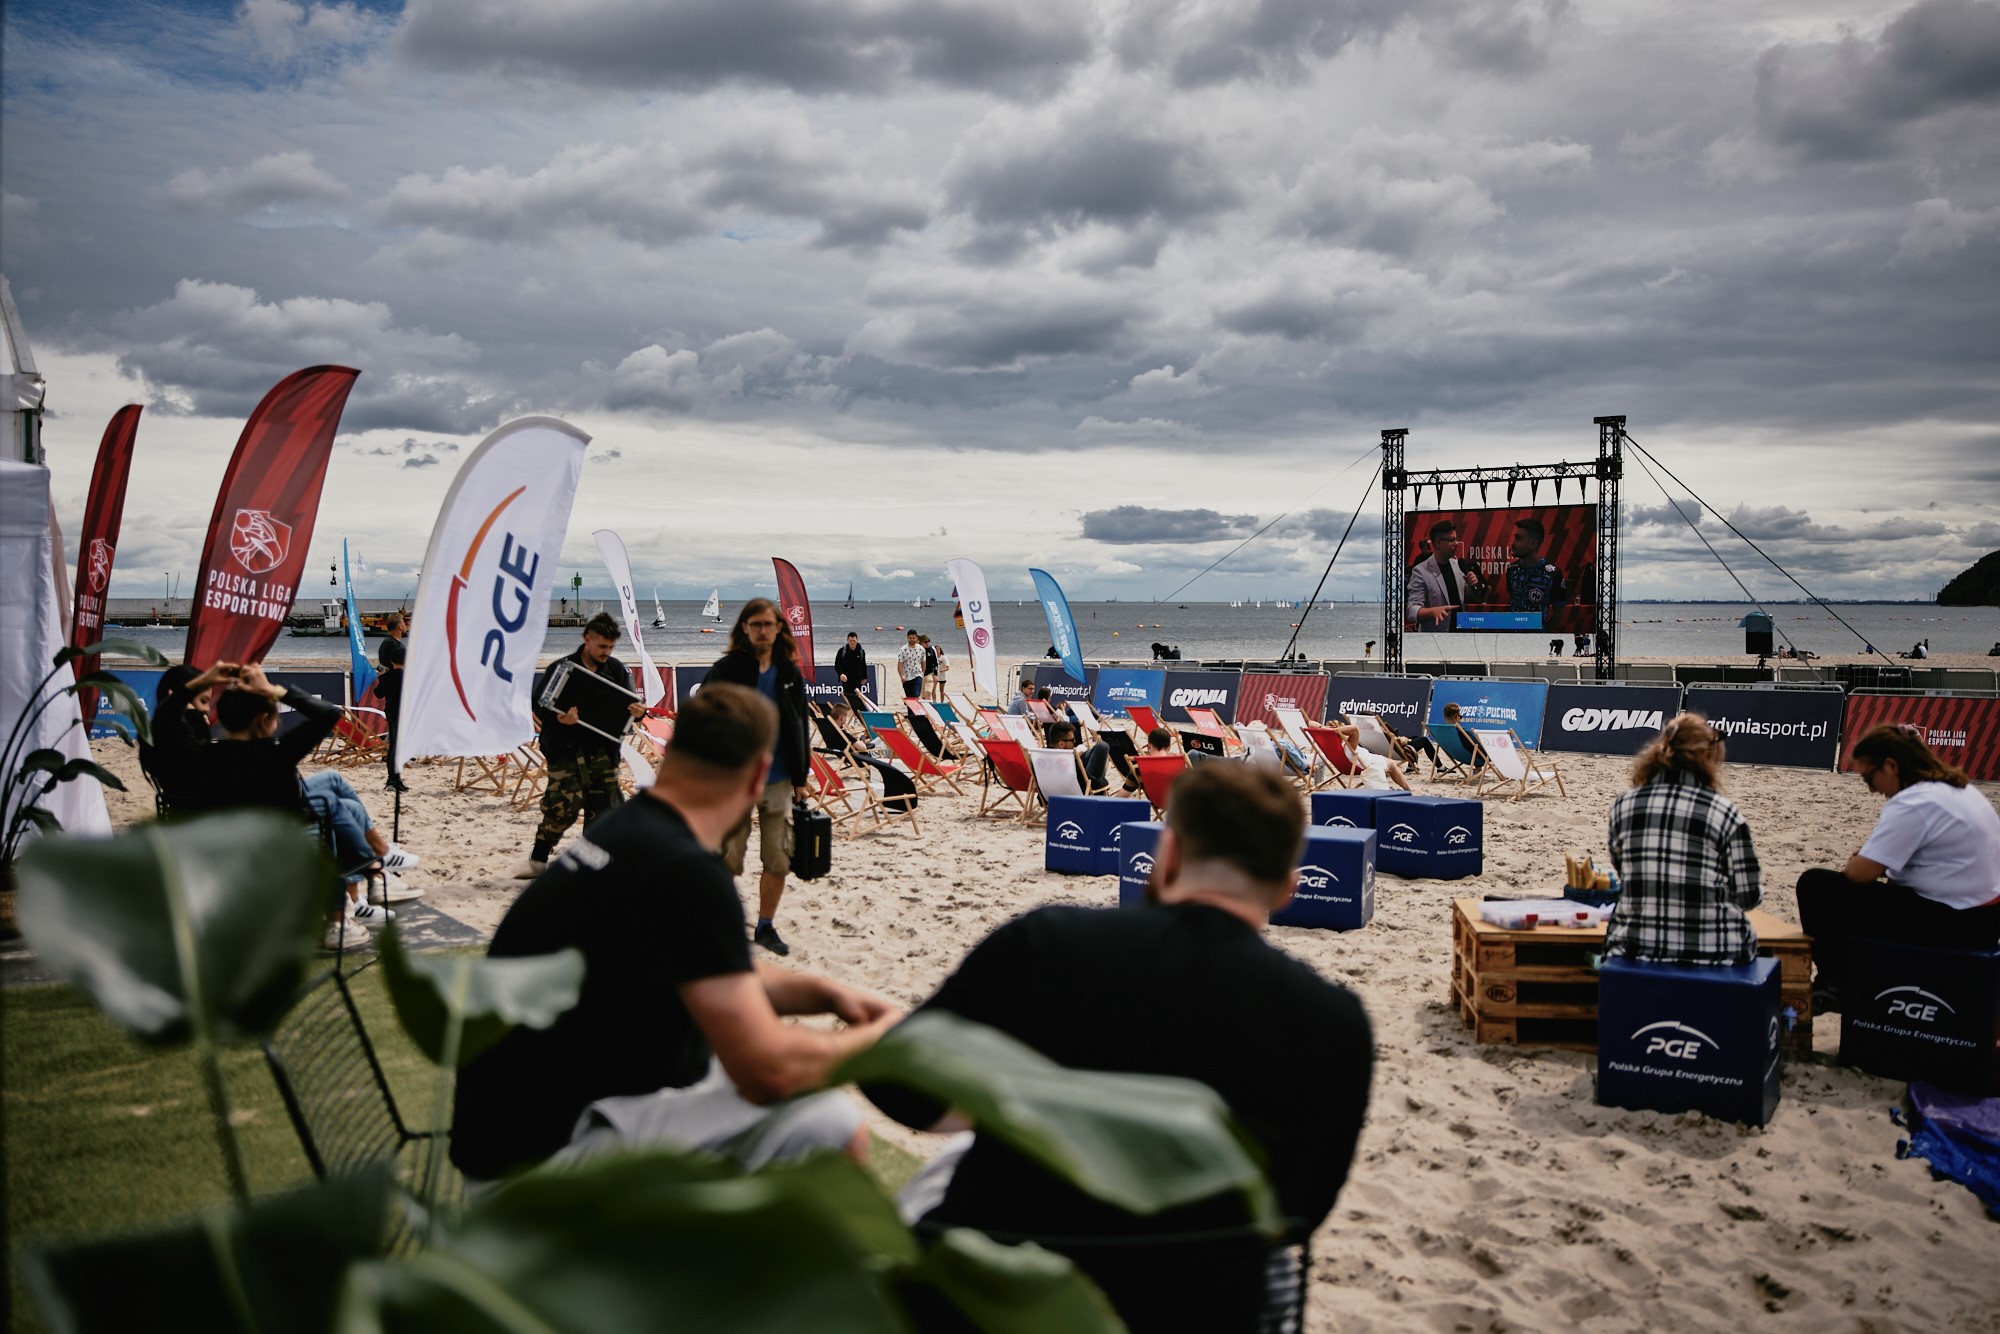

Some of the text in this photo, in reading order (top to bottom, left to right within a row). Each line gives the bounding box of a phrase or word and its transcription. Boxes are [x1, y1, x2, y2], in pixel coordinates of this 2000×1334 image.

[1469, 546, 1502, 560] POLSKA
[209, 569, 292, 604] POLSKA LIGA
[205, 589, 287, 622] ESPORTOWA
[481, 531, 540, 683] PGE
[1169, 688, 1228, 707] GDYNIA
[1338, 699, 1419, 718] gdyniasport.pl
[1486, 706, 1517, 721] PUCHAR
[1561, 707, 1664, 732] GDYNIA
[1928, 730, 1967, 739] POLSKA LIGA
[1202, 741, 1215, 751] LG
[1927, 738, 1966, 747] ESPORTOWA
[1060, 829, 1079, 840] PGE
[1393, 831, 1413, 843] PGE
[1448, 834, 1467, 845] PGE
[1134, 861, 1153, 875] PGE
[1296, 875, 1329, 889] PGE
[1294, 892, 1313, 900] Grupa
[1313, 893, 1353, 903] Energetyczna
[1888, 999, 1939, 1022] PGE
[1853, 1019, 1977, 1049] Polska Grupa Energetyczna
[1646, 1036, 1701, 1060] PGE
[1608, 1061, 1744, 1086] Polska Grupa Energetyczna
